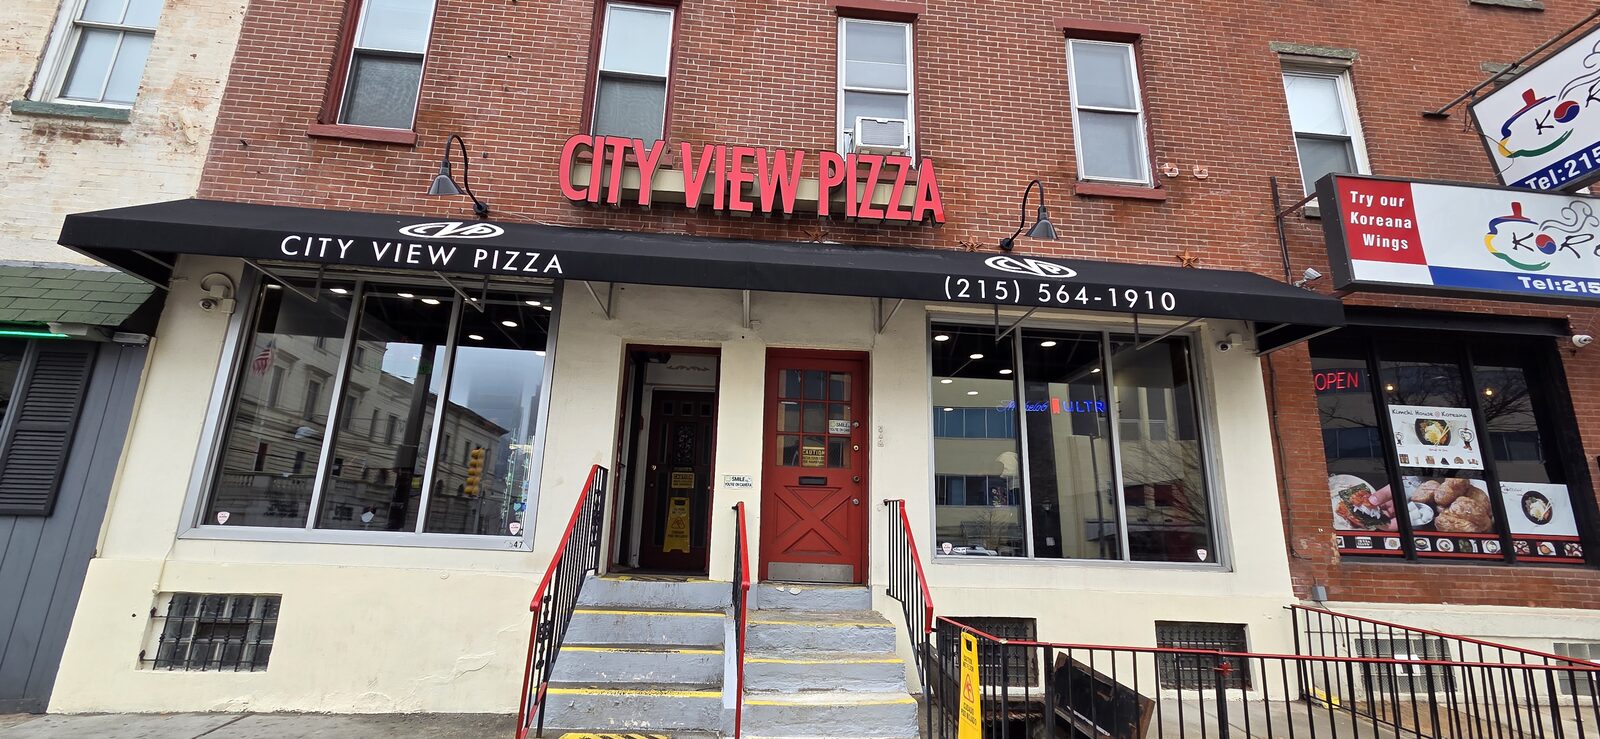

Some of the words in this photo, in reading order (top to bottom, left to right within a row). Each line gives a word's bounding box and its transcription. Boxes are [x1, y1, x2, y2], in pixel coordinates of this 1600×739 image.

[559, 134, 665, 204] CITY
[681, 142, 805, 214] VIEW
[819, 151, 946, 223] PIZZA
[1350, 190, 1374, 208] Try
[1380, 197, 1405, 208] our
[1350, 211, 1412, 229] Koreana
[1362, 233, 1409, 251] Wings
[1512, 232, 1600, 259] KOR
[280, 235, 354, 259] CITY
[373, 241, 457, 266] VIEW
[473, 248, 563, 274] PIZZA
[944, 275, 1021, 303] (215)
[1037, 283, 1176, 312] 564-1910
[1314, 371, 1359, 391] OPEN
[1063, 401, 1106, 413] ULTR
